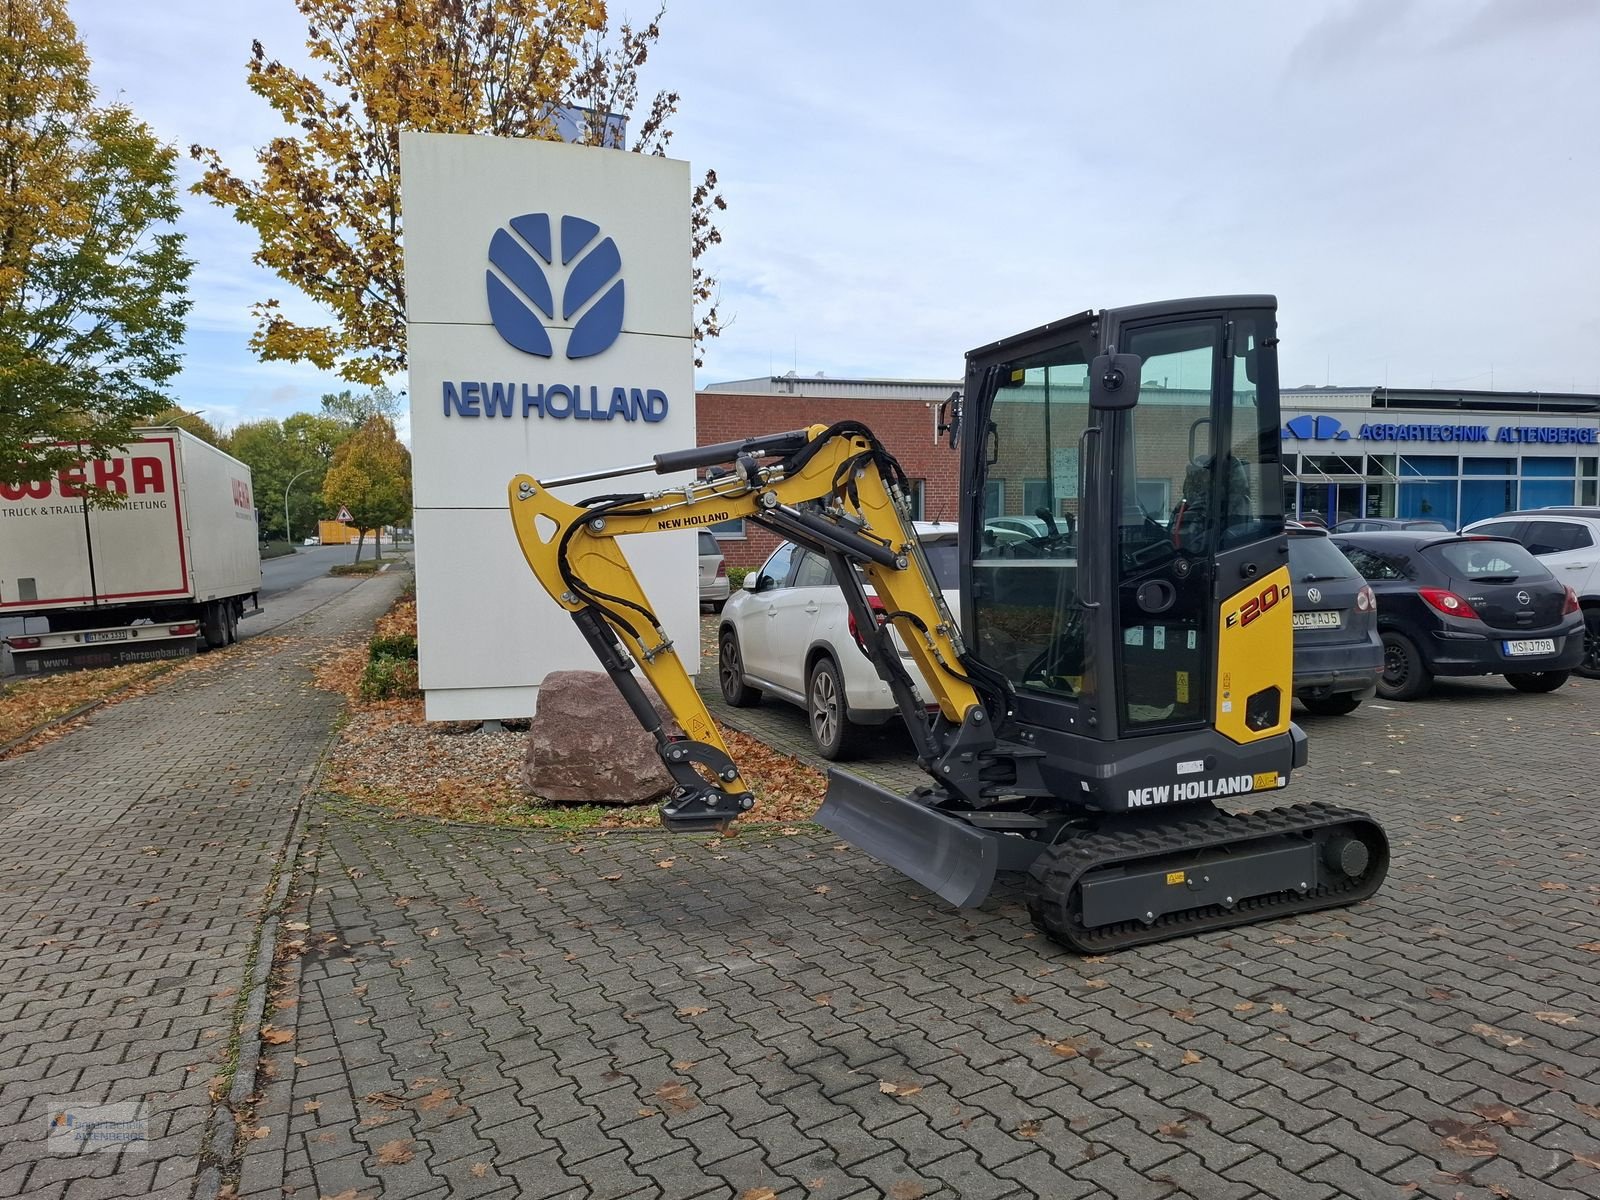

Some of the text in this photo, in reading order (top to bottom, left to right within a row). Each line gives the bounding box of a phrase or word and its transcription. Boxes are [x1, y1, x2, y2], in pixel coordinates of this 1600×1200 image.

[442, 381, 669, 423] NEW HOLLAND
[1359, 423, 1599, 445] AGRARTECHNIK ALTENBERGE
[2, 507, 38, 518] TRUCK
[40, 506, 48, 516] &
[49, 503, 94, 516] TRAILER
[657, 511, 729, 530] NEW HOLLAND
[1292, 612, 1338, 626] COE AJ5
[1512, 640, 1551, 652] MS J798
[43, 658, 72, 668] www.
[1127, 774, 1253, 808] NEW HOLLAND
